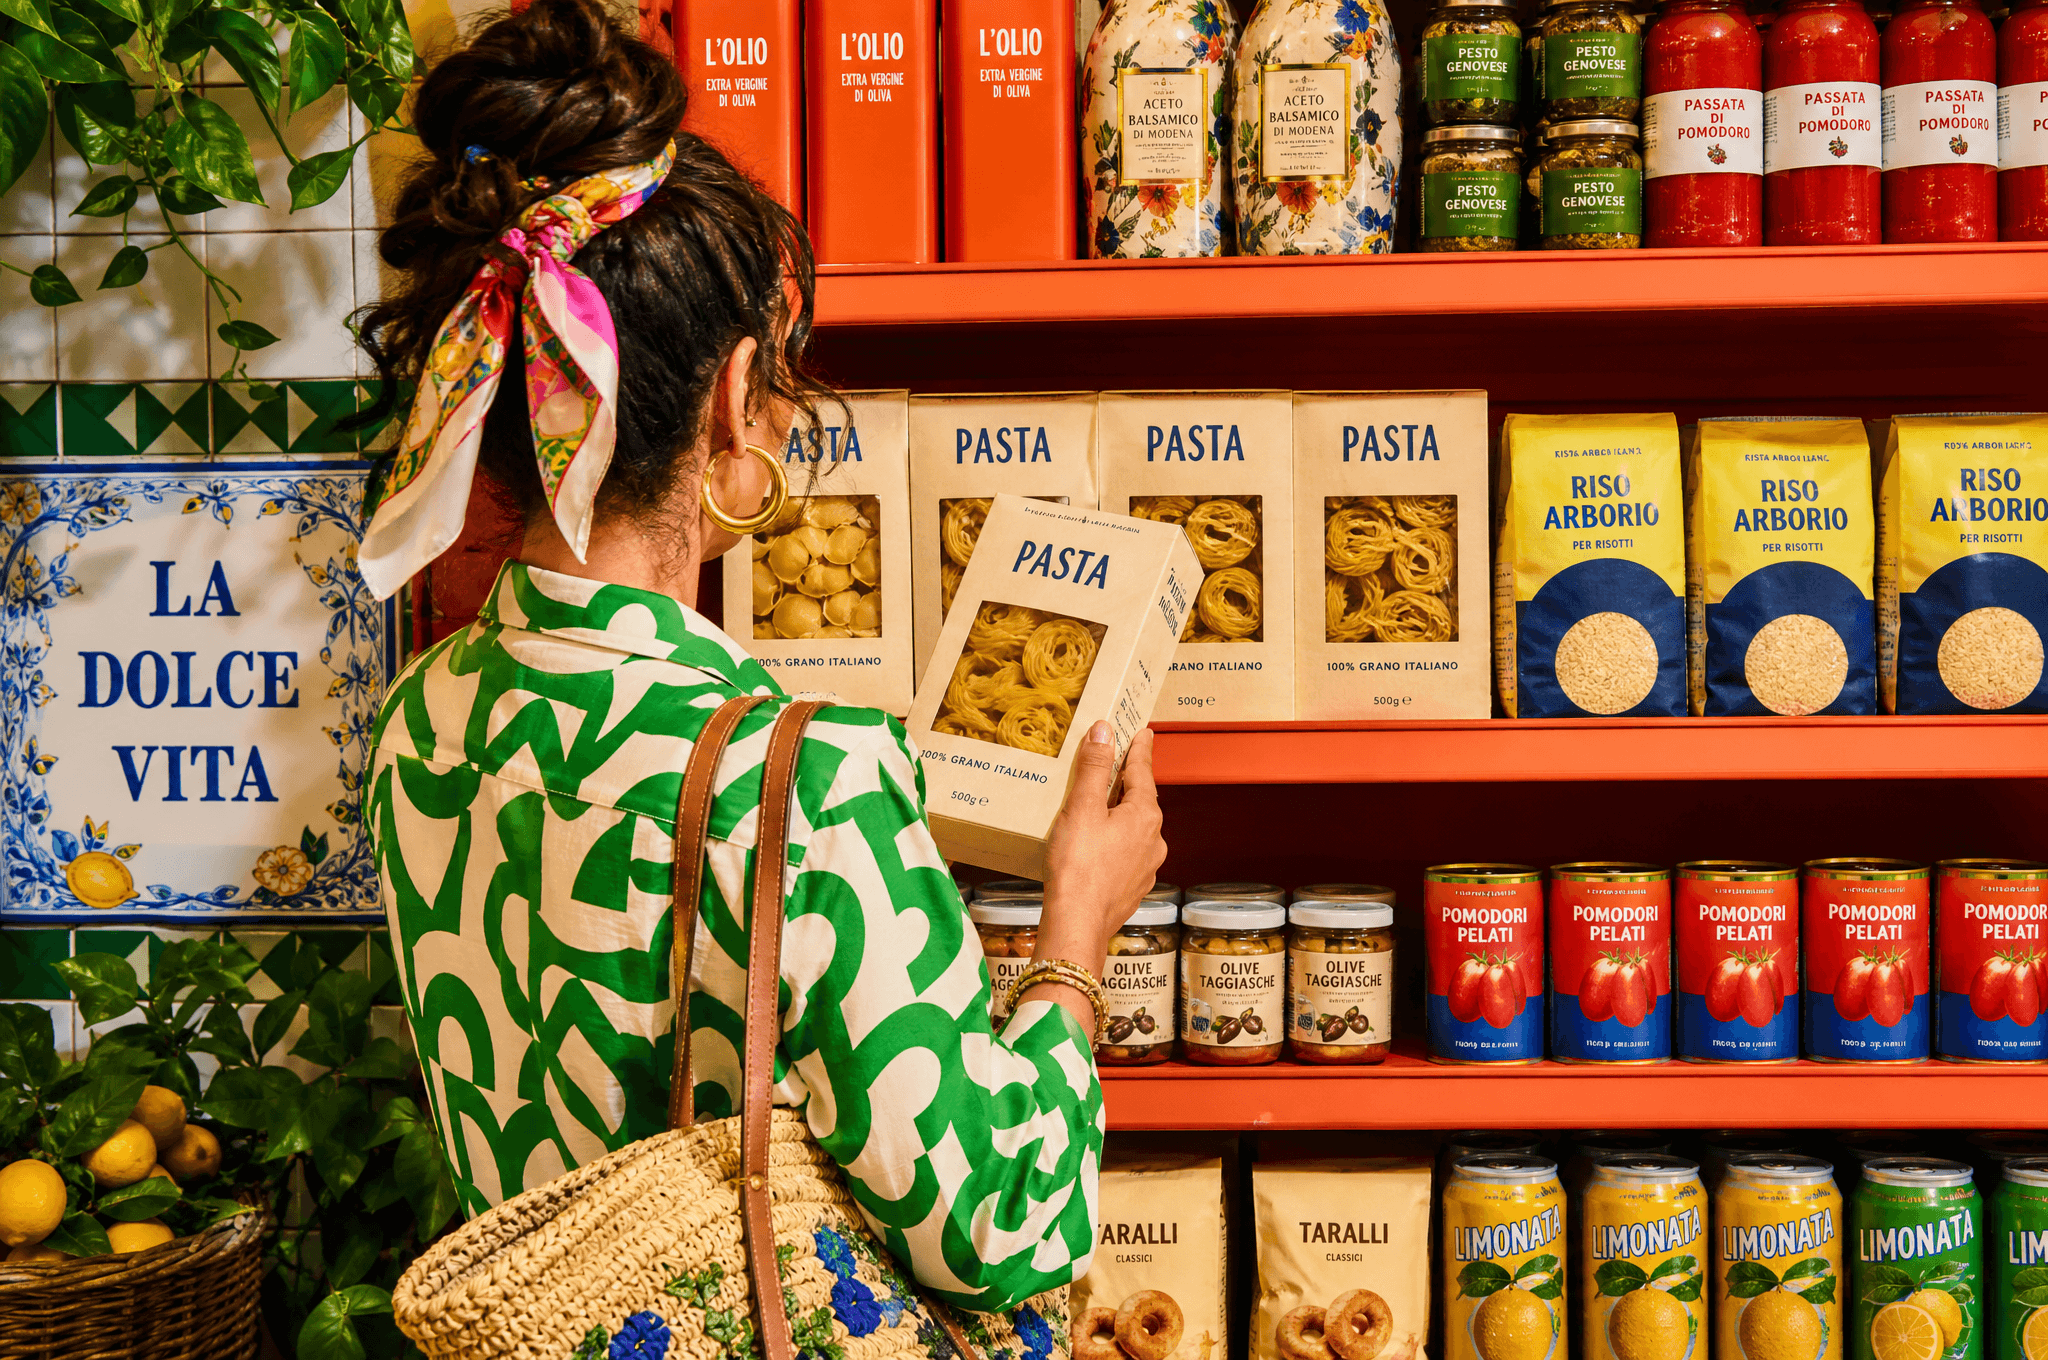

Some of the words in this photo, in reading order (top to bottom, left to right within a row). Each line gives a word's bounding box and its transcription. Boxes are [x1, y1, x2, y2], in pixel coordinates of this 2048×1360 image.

[841, 32, 904, 61] L'OLIO
[979, 27, 1043, 57] L'OLIO
[705, 37, 768, 66] L'OLIO
[1458, 47, 1498, 59] PESTO
[1576, 45, 1616, 57] PESTO
[1446, 61, 1508, 73] GENOVESE
[1563, 59, 1627, 71] GENOVESE
[841, 73, 867, 86] EXTRA
[871, 72, 904, 86] VERGINE
[980, 68, 1006, 82] EXTRA
[1009, 68, 1043, 82] VERGINE
[706, 78, 732, 91] EXTRA
[735, 77, 768, 91] VERGINE
[993, 85, 1001, 98] DI
[1006, 84, 1030, 98] OLIVA
[719, 94, 728, 107] DI
[732, 94, 756, 107] OLIVA
[855, 89, 863, 102] DI
[868, 89, 892, 102] OLIVA
[1284, 94, 1324, 106] ACETO
[1804, 91, 1866, 105] PASSATA
[1925, 89, 1984, 103] PASSATA
[1143, 98, 1183, 110] ACETO
[1684, 98, 1745, 112] PASSATA
[1831, 105, 1845, 117] DI
[1952, 103, 1965, 115] DI
[1128, 114, 1199, 126] BALSAMICO
[1269, 110, 1340, 123] BALSAMICO
[1710, 112, 1724, 124] DI
[1273, 126, 1284, 137] DI
[1288, 125, 1335, 136] MODENA
[1798, 119, 1871, 133] POMODORO
[1919, 118, 1990, 132] POMODORO
[1133, 129, 1143, 139] DI
[1148, 128, 1194, 139] MODENA
[1677, 126, 1750, 140] POMODORO
[1457, 185, 1497, 197] PESTO
[1574, 181, 1615, 194] PESTO
[1445, 199, 1507, 211] GENOVESE
[1561, 195, 1626, 207] GENOVESE
[785, 426, 863, 463] ASTA
[956, 426, 1052, 465] PASTA
[1146, 424, 1245, 463] PASTA
[1342, 424, 1441, 463] PASTA
[1571, 473, 1631, 499] RISO
[1960, 467, 2022, 492] RISO
[1760, 479, 1819, 503] RISO
[1543, 501, 1660, 530] ARBORIO
[1929, 497, 2048, 522] ARBORIO
[1733, 507, 1848, 533] ARBORIO
[1573, 540, 1592, 550] PER
[1595, 538, 1634, 550] RISOTTI
[1960, 533, 1980, 543] PER
[1983, 533, 2023, 543] RISOTTI
[1762, 543, 1782, 553] PER
[1785, 542, 1824, 552] RISOTTI
[1011, 539, 1110, 590] PASTA
[149, 560, 241, 617] LA
[785, 657, 825, 667] GRANO
[829, 657, 882, 667] ITALIANO
[1168, 662, 1204, 671] RANO
[1208, 661, 1263, 671] ITALIANO
[1327, 662, 1355, 672] 100%
[1359, 661, 1401, 671] GRANO
[1404, 661, 1459, 671] ITALIANO
[77, 649, 300, 710] DOLCE
[1177, 696, 1204, 708] 500g
[1373, 696, 1400, 708] 500g
[111, 745, 280, 802] VITA
[920, 749, 947, 762] 100%
[950, 755, 991, 771] GRANO
[993, 764, 1048, 784] ITALIANO
[951, 790, 977, 806] 500g
[1441, 906, 1528, 924] POMODORI
[1573, 905, 1659, 923] POMODORI
[1699, 904, 1786, 922] POMODORI
[1828, 903, 1917, 921] POMODORI
[1964, 902, 2048, 921] POMODOR
[1457, 926, 1513, 943] PELATI
[1589, 925, 1646, 942] PELATI
[1716, 924, 1773, 941] PELATI
[1845, 923, 1903, 940] PELATI
[1982, 923, 2039, 940] PELATI
[1113, 961, 1153, 976] OLIVE
[1220, 961, 1260, 975] OLIVE
[1326, 960, 1366, 974] OLIVE
[1101, 974, 1168, 990] AGGIASCHE
[1200, 974, 1275, 990] TAGGIASCHE
[1305, 972, 1382, 988] TAGGIASCHE
[1098, 1222, 1178, 1245] ARALLI
[1299, 1222, 1389, 1245] TARALLI
[1454, 1204, 1562, 1261] LIMONATA
[1592, 1204, 1702, 1260] LIMONATA
[1722, 1207, 1835, 1262] LIMONATA
[1859, 1207, 1975, 1263] LIMONATA
[1115, 1254, 1153, 1263] CLASSICI
[1325, 1253, 1364, 1263] CLASSICI
